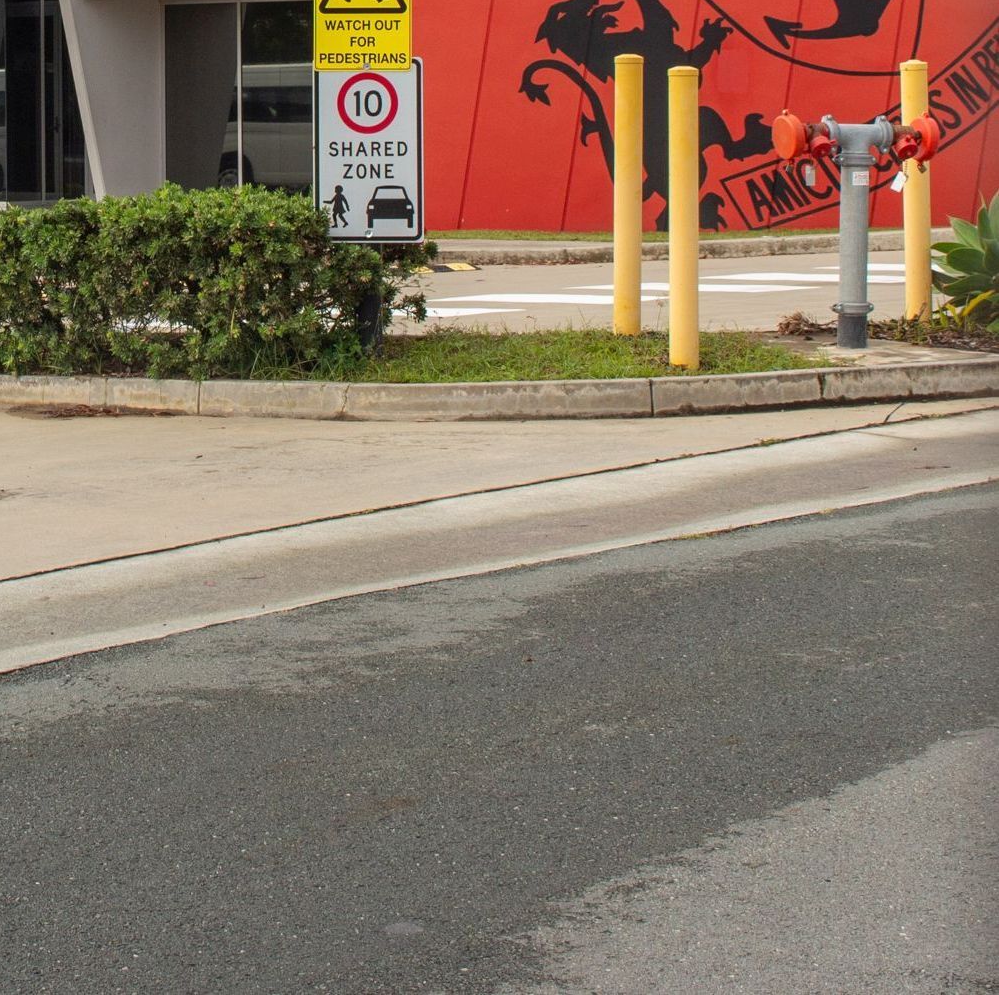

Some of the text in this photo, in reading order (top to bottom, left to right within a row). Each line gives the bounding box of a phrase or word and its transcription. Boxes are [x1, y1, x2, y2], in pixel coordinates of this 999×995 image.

[325, 19, 401, 31] WATCH OUT
[350, 36, 376, 47] FOR
[319, 53, 407, 65] PEDESTRIANS
[944, 64, 991, 115] IN
[353, 90, 383, 117] 10
[329, 141, 408, 157] SHARED
[343, 163, 394, 179] ZONE
